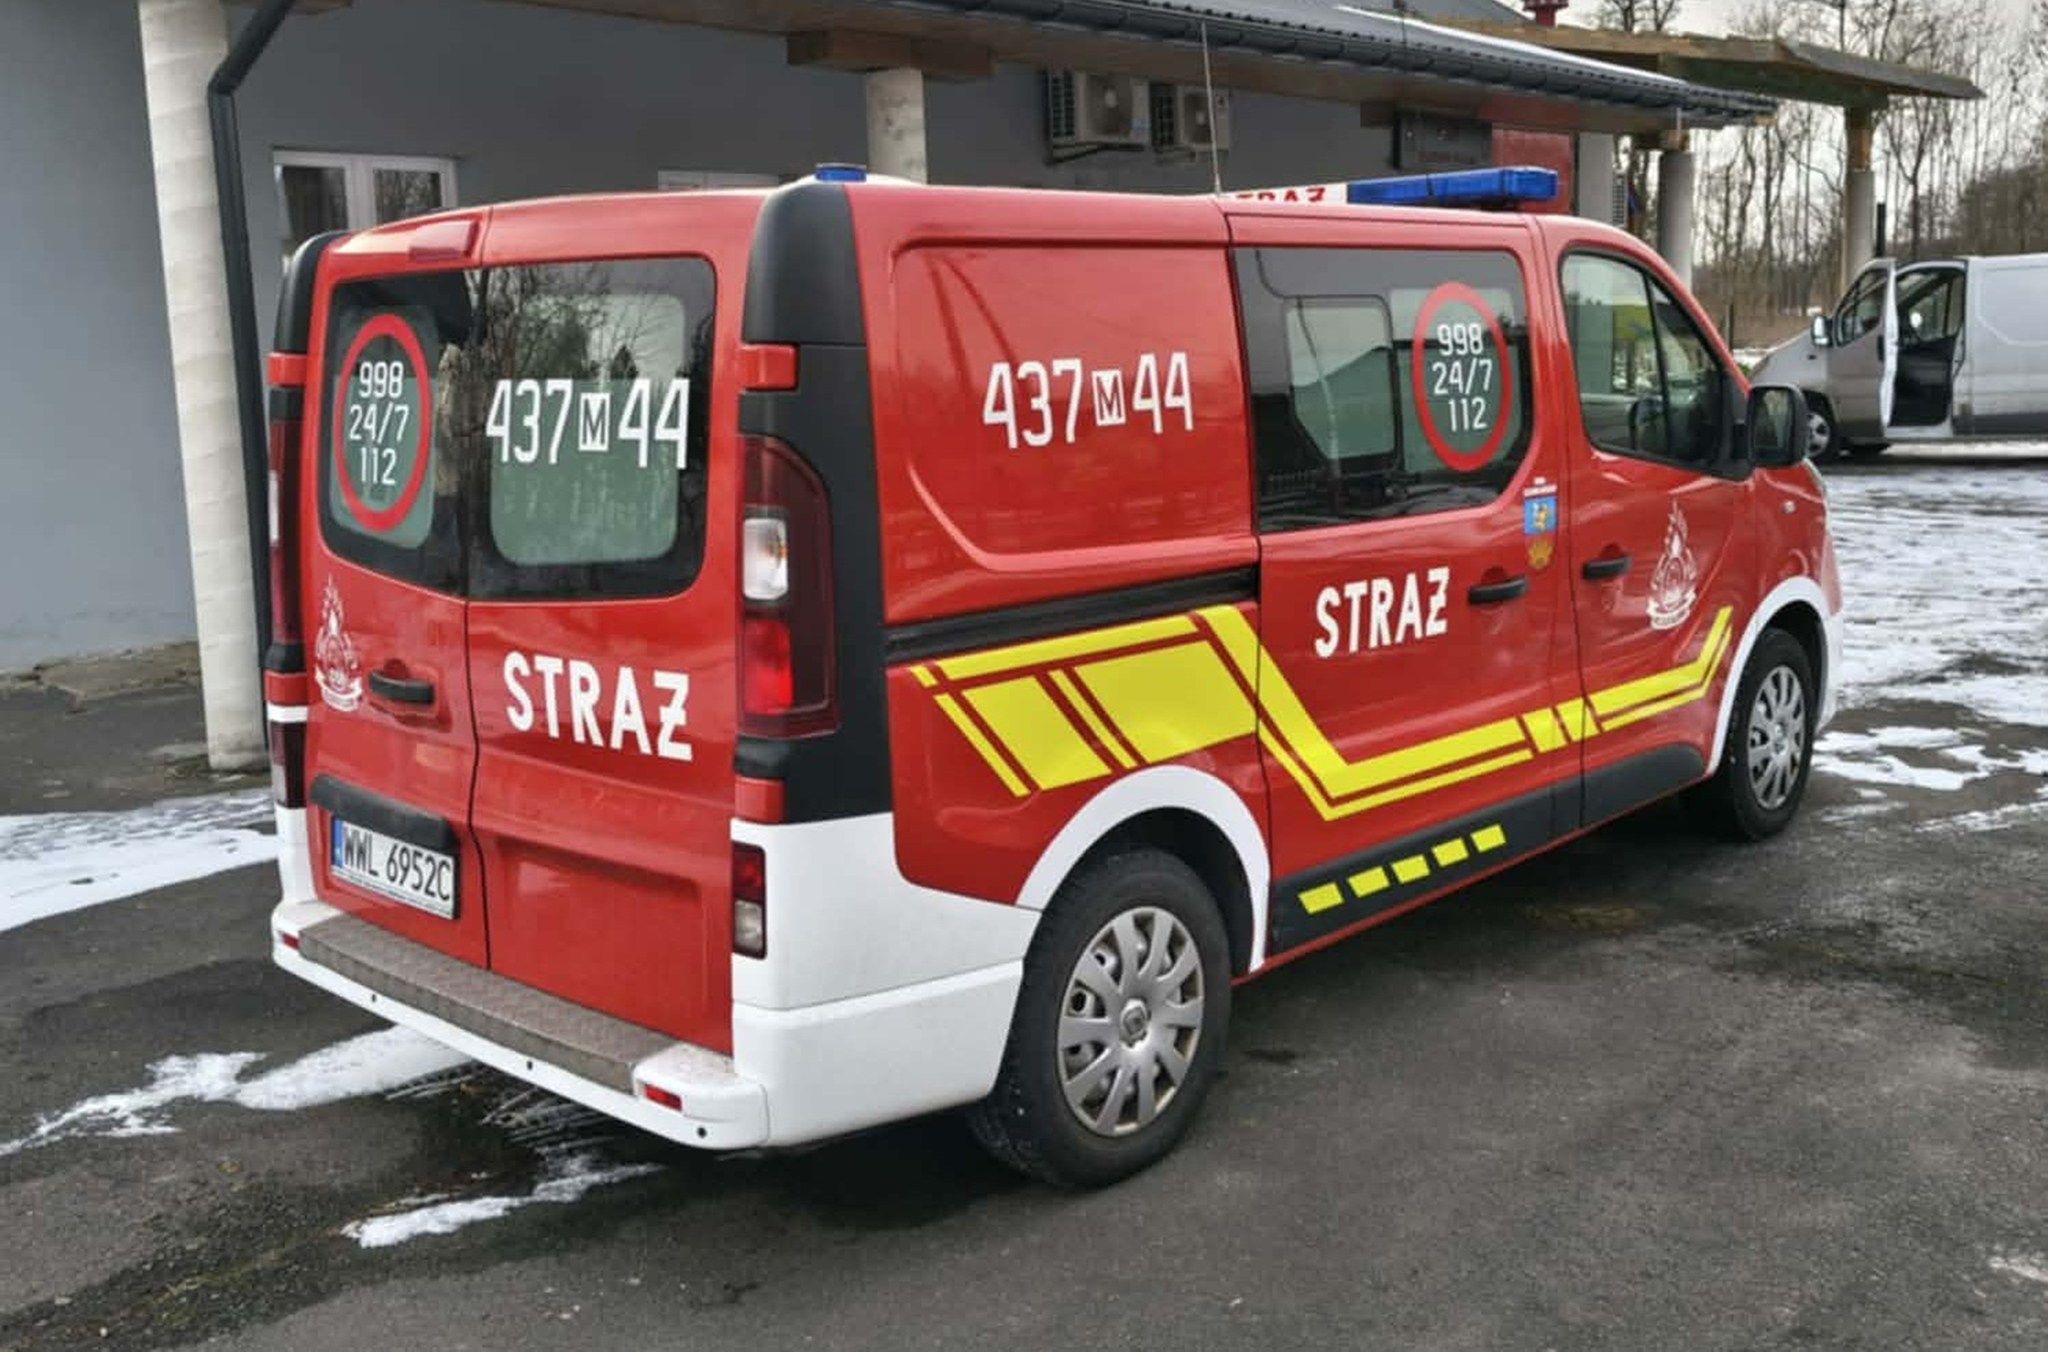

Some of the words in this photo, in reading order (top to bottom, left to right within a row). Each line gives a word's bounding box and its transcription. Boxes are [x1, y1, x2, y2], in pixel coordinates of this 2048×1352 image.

[1437, 323, 1483, 356] 998
[359, 361, 403, 399] 998
[1432, 358, 1492, 396] 24/7
[349, 401, 409, 444] 24/7
[1448, 397, 1487, 433] 112
[361, 447, 397, 486] 112
[344, 826, 379, 877] WWL
[386, 842, 451, 901] 6952C
